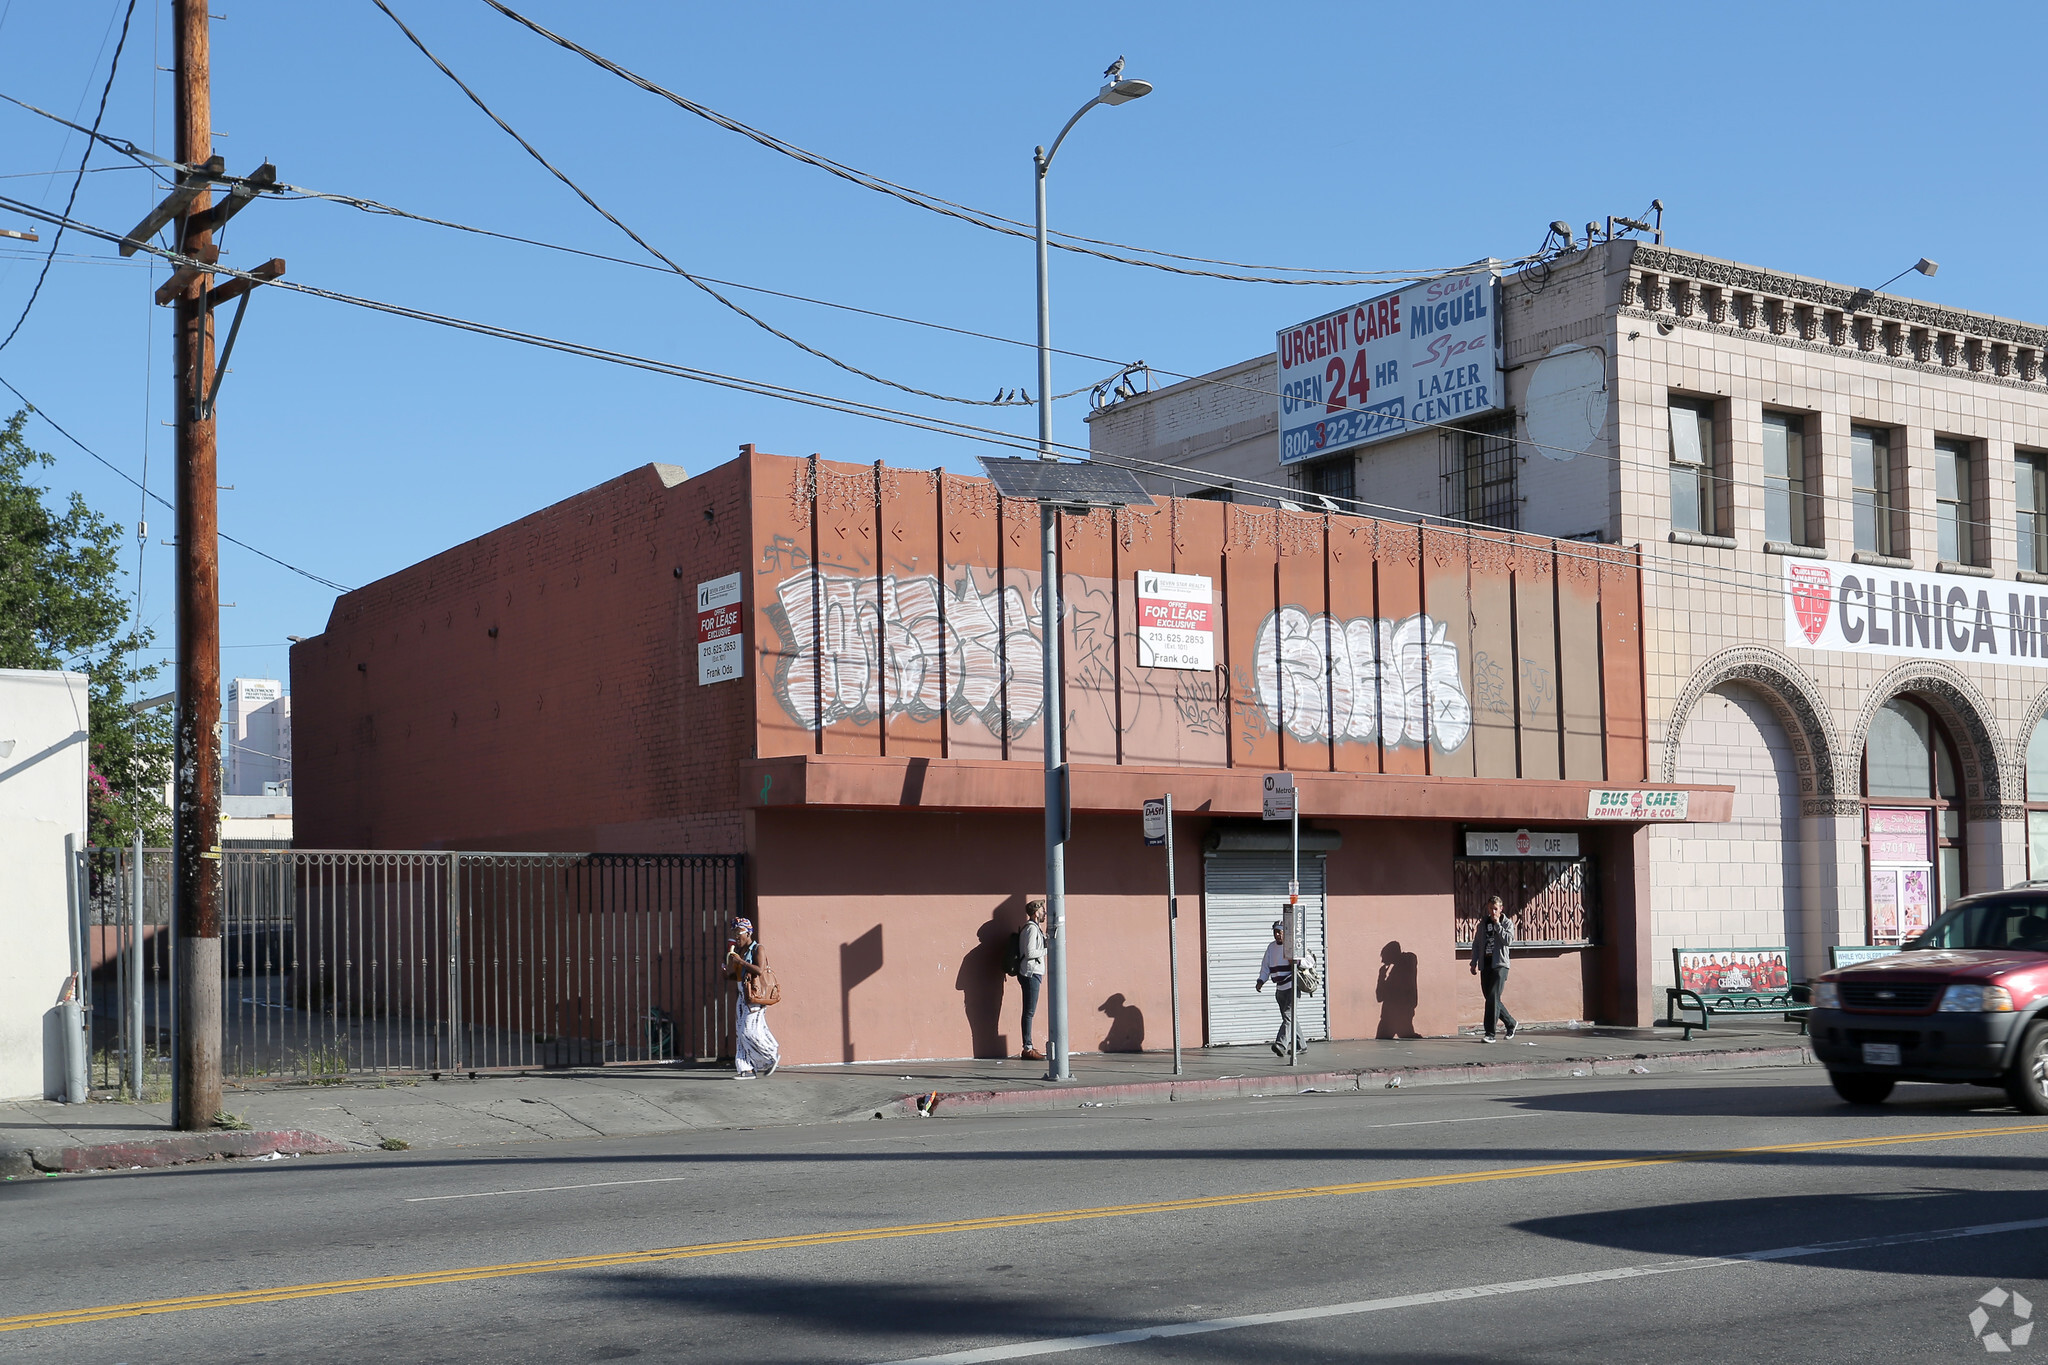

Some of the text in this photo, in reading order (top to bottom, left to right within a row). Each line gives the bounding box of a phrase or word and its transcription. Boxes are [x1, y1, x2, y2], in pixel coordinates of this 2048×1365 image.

[1426, 276, 1472, 302] San
[1410, 284, 1487, 340] MIGUEL
[1281, 295, 1401, 370] URGENT CARE
[1412, 333, 1487, 368] Spa
[1283, 348, 1399, 415] OPEN 24 HR
[1418, 363, 1481, 400] LAZER
[1411, 385, 1489, 424] CENTER
[1284, 402, 1402, 459] 800-322-2222
[1168, 601, 1188, 609] OFFICE
[1145, 605, 1207, 622] FOR LEASE
[1838, 574, 1998, 655] CLINICA
[701, 611, 738, 632] FOR LEASE
[1156, 618, 1197, 630] EXCLUSIVE
[708, 626, 732, 640] EXCLUSIVE
[1149, 632, 1205, 645] 213.625.2853
[1154, 653, 1199, 665] Frank Oda
[707, 665, 733, 679] Frank Oda
[1264, 799, 1268, 807] 4
[1600, 792, 1629, 806] BUS
[1646, 792, 1679, 806] CAFE
[1145, 806, 1164, 816] DASH
[1264, 809, 1276, 817] 704
[1594, 807, 1622, 817] DRINK
[1630, 808, 1648, 818] HOT
[1650, 809, 1658, 818] &
[1484, 838, 1560, 852] BUS STOP CAFE
[1296, 937, 1303, 949] Go
[1838, 952, 1854, 960] WHILE
[1855, 952, 1866, 960] YOU
[1718, 977, 1752, 988] CHRISTMAS
